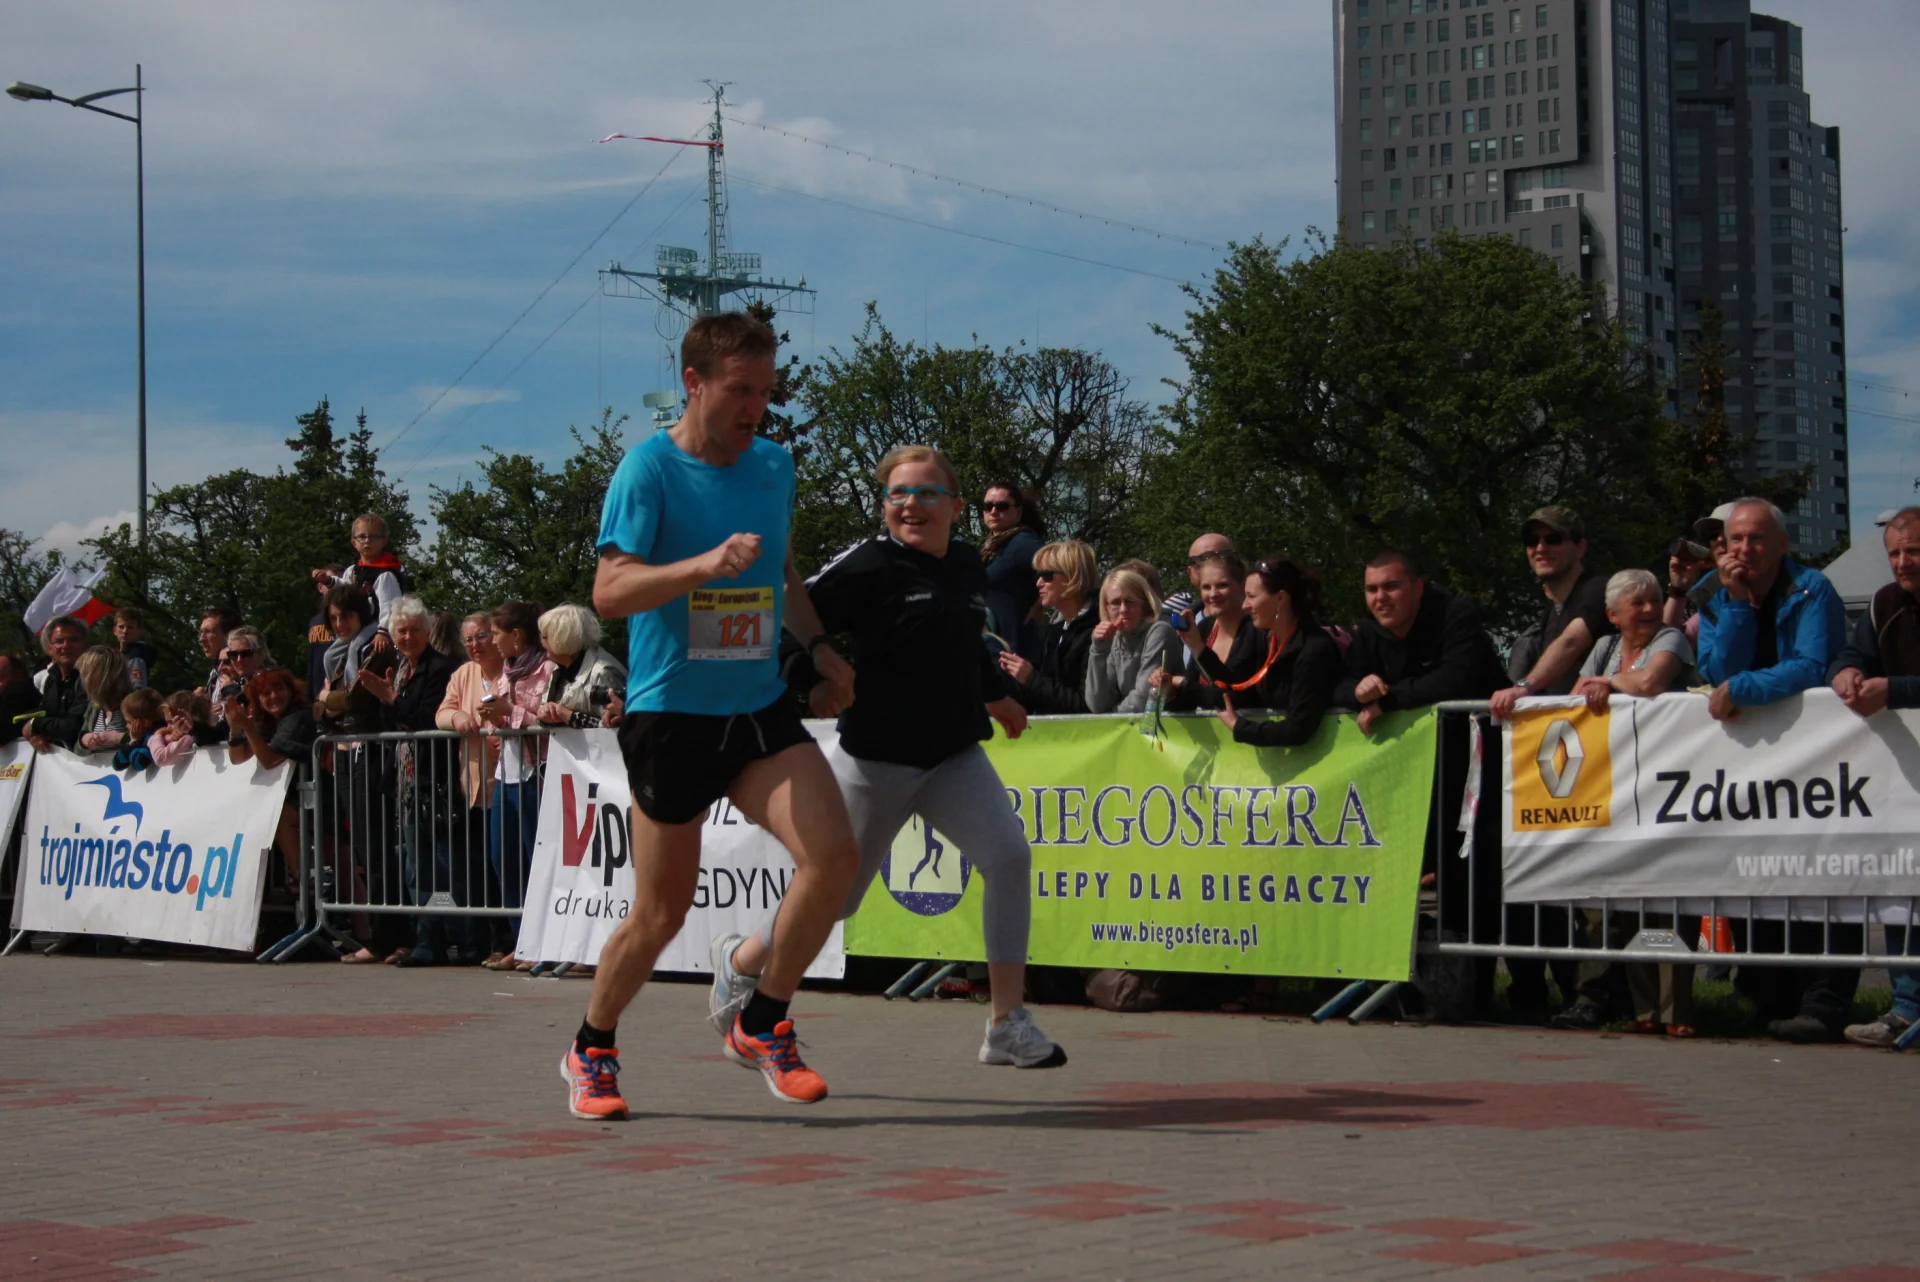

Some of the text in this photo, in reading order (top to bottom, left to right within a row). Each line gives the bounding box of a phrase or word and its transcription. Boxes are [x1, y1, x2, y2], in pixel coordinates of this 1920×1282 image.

[719, 613, 760, 647] 121
[1655, 762, 1872, 824] Zdunek
[1521, 805, 1602, 825] RENAULT
[554, 889, 636, 919] druka
[693, 867, 796, 909] GDYN
[1031, 870, 1372, 904] LEPY DLA BIEGACZY
[1091, 921, 1258, 952] www.biegosfera.pl
